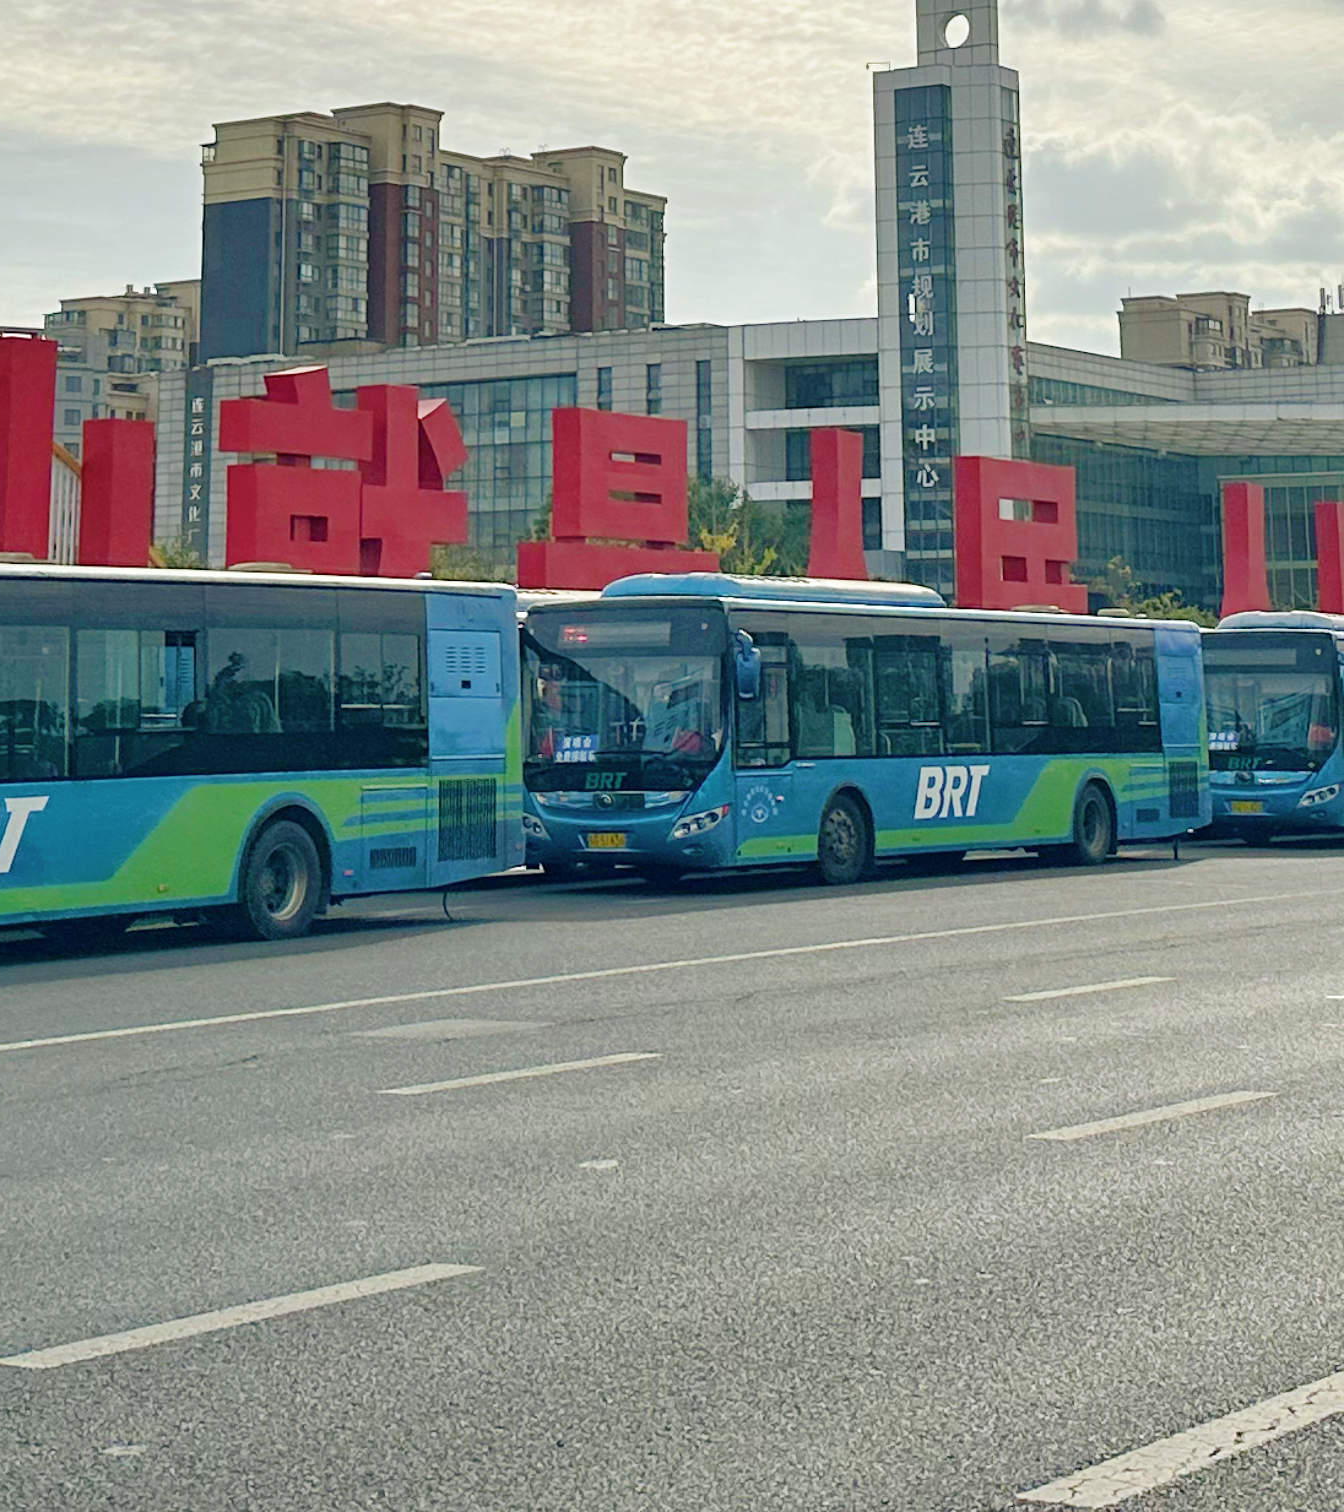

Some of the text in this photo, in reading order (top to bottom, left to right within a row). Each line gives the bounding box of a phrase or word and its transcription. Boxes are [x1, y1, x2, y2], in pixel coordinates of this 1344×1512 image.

[907, 125, 939, 488] 连云港市规划展示中心
[585, 772, 627, 789] BRT
[914, 765, 990, 819] BRT
